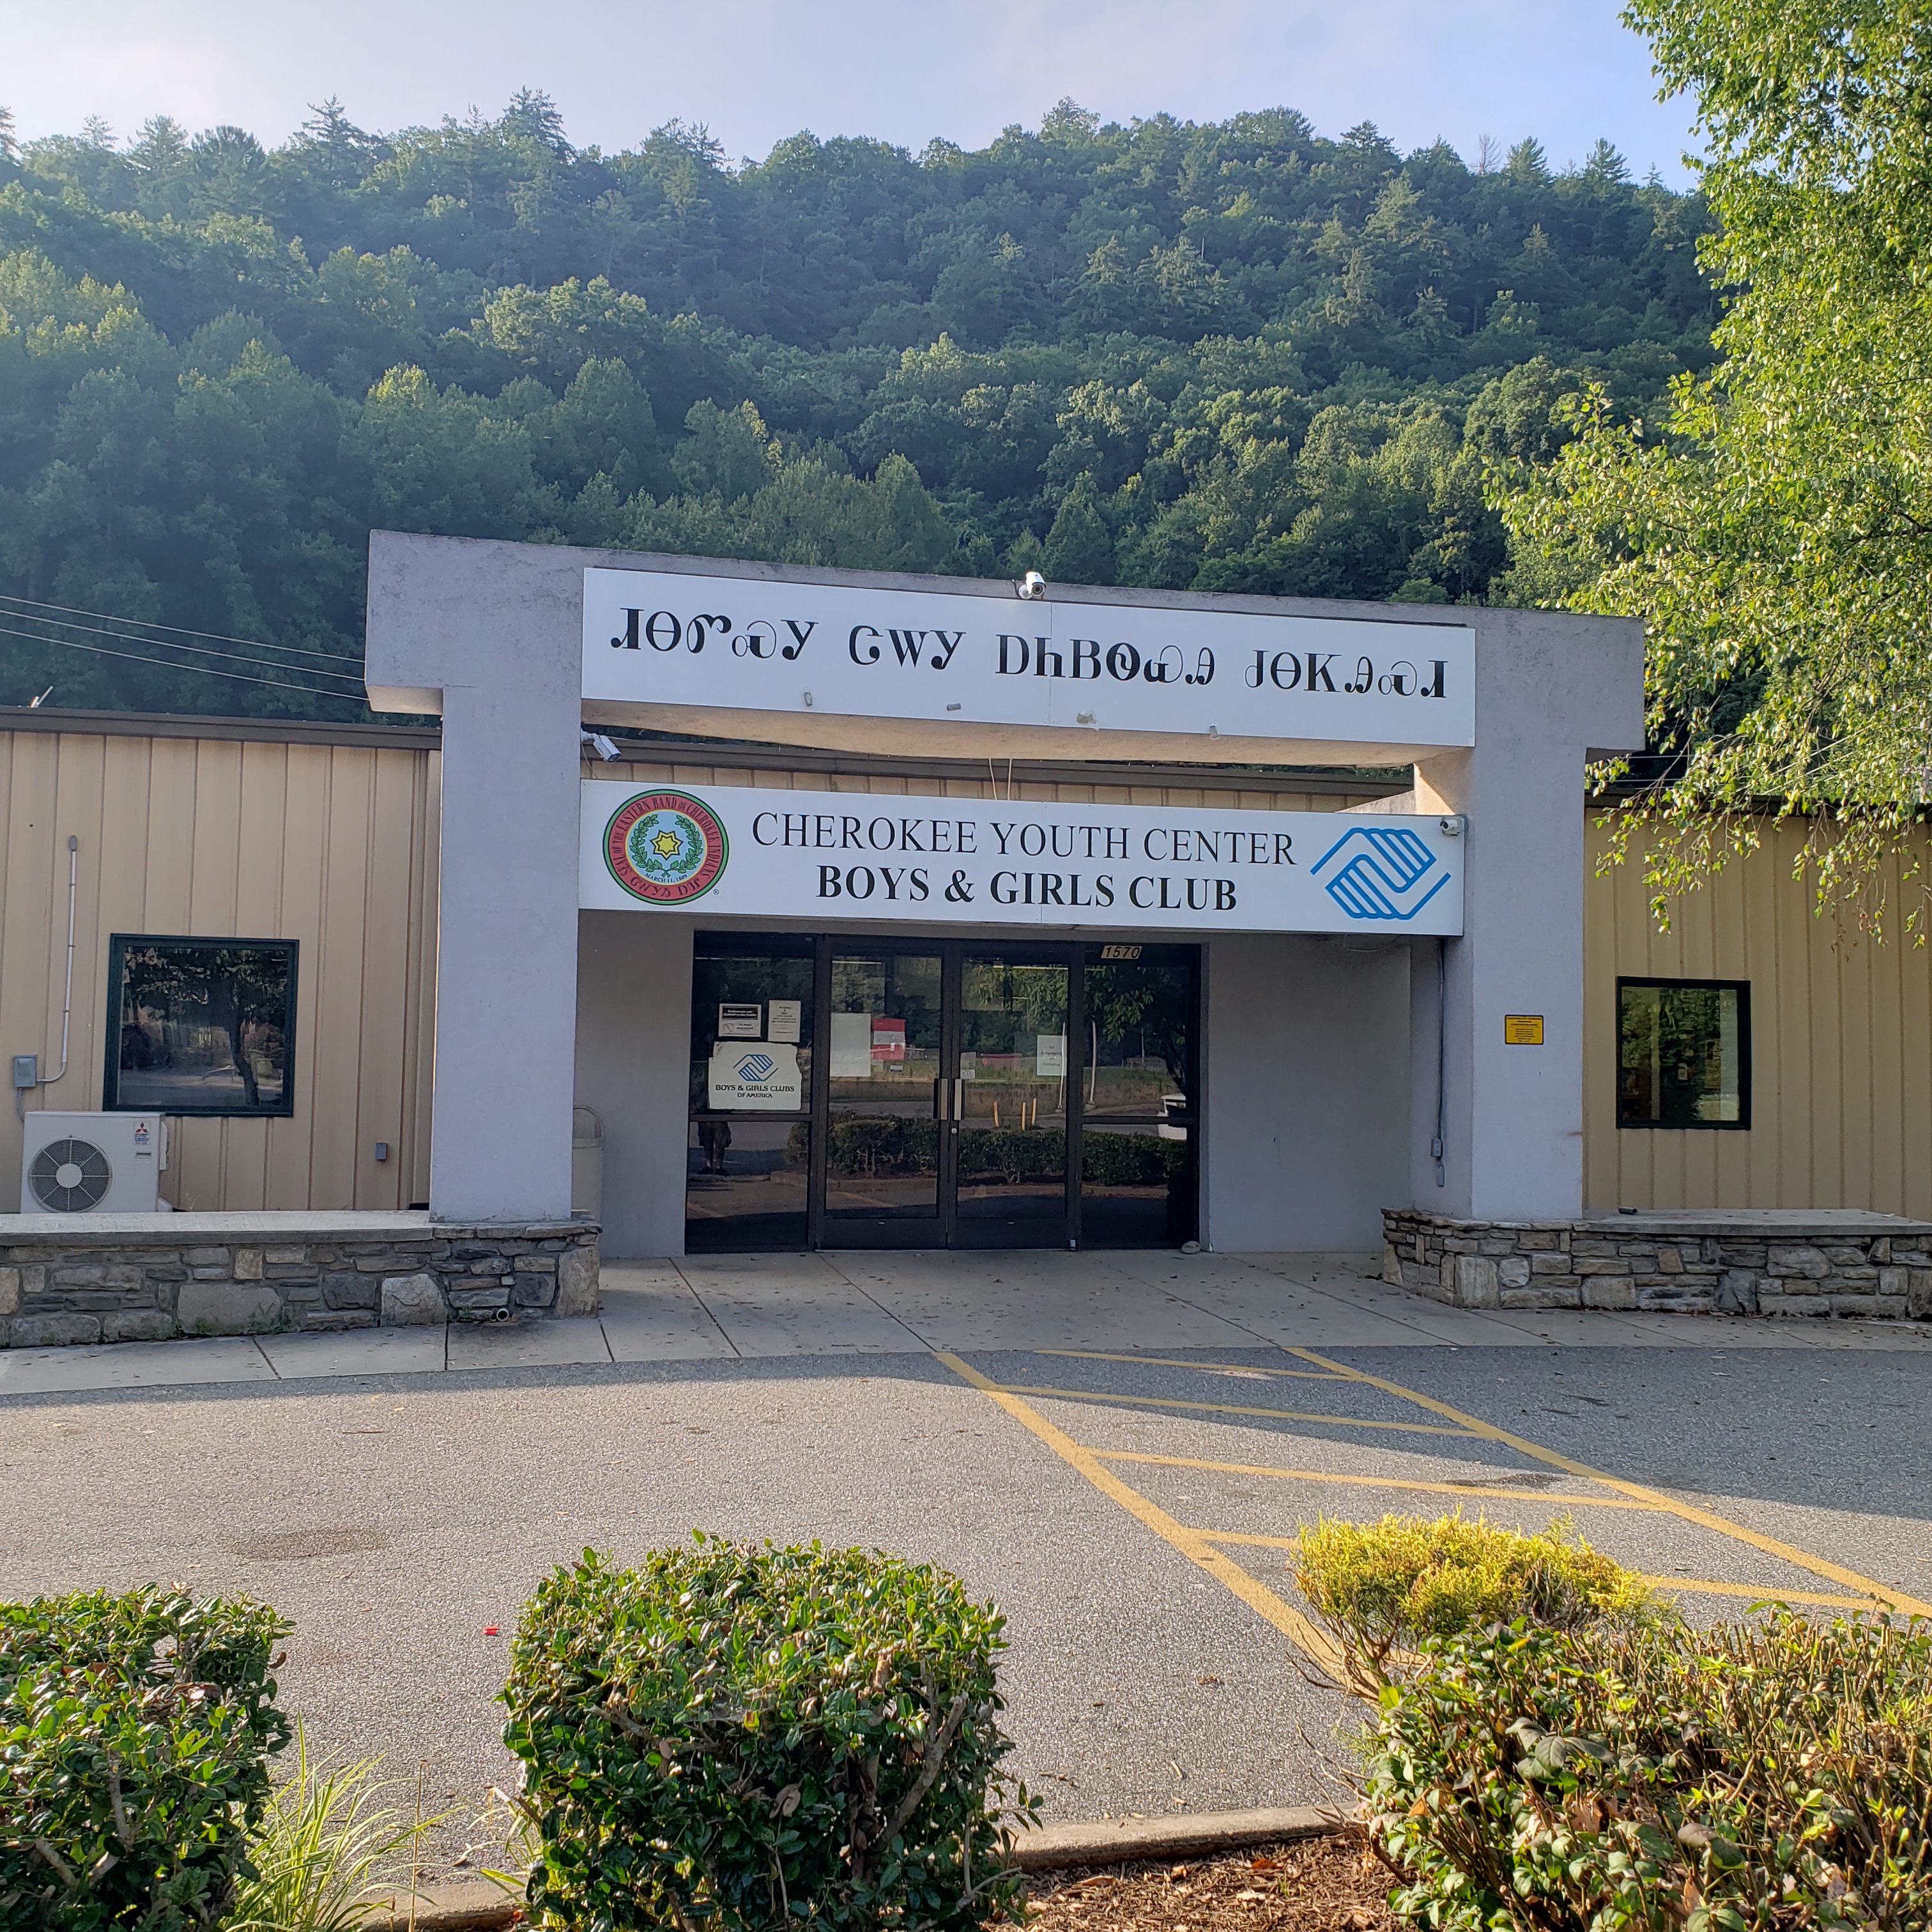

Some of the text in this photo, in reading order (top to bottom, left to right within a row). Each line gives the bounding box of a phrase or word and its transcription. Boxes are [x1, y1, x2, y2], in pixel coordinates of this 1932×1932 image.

[848, 625, 967, 670] ᏣᎳᎩ
[616, 799, 651, 831] EASTERN
[652, 797, 677, 809] BAND
[686, 803, 720, 843] CHEROKEE
[752, 812, 1298, 865] CHEROKEE YOUTH CENTER
[644, 873, 666, 884] MARCH
[700, 845, 721, 879] INDIANS
[815, 864, 1237, 910] BOYS & GIRLS CLUB
[1105, 946, 1140, 958] 1570
